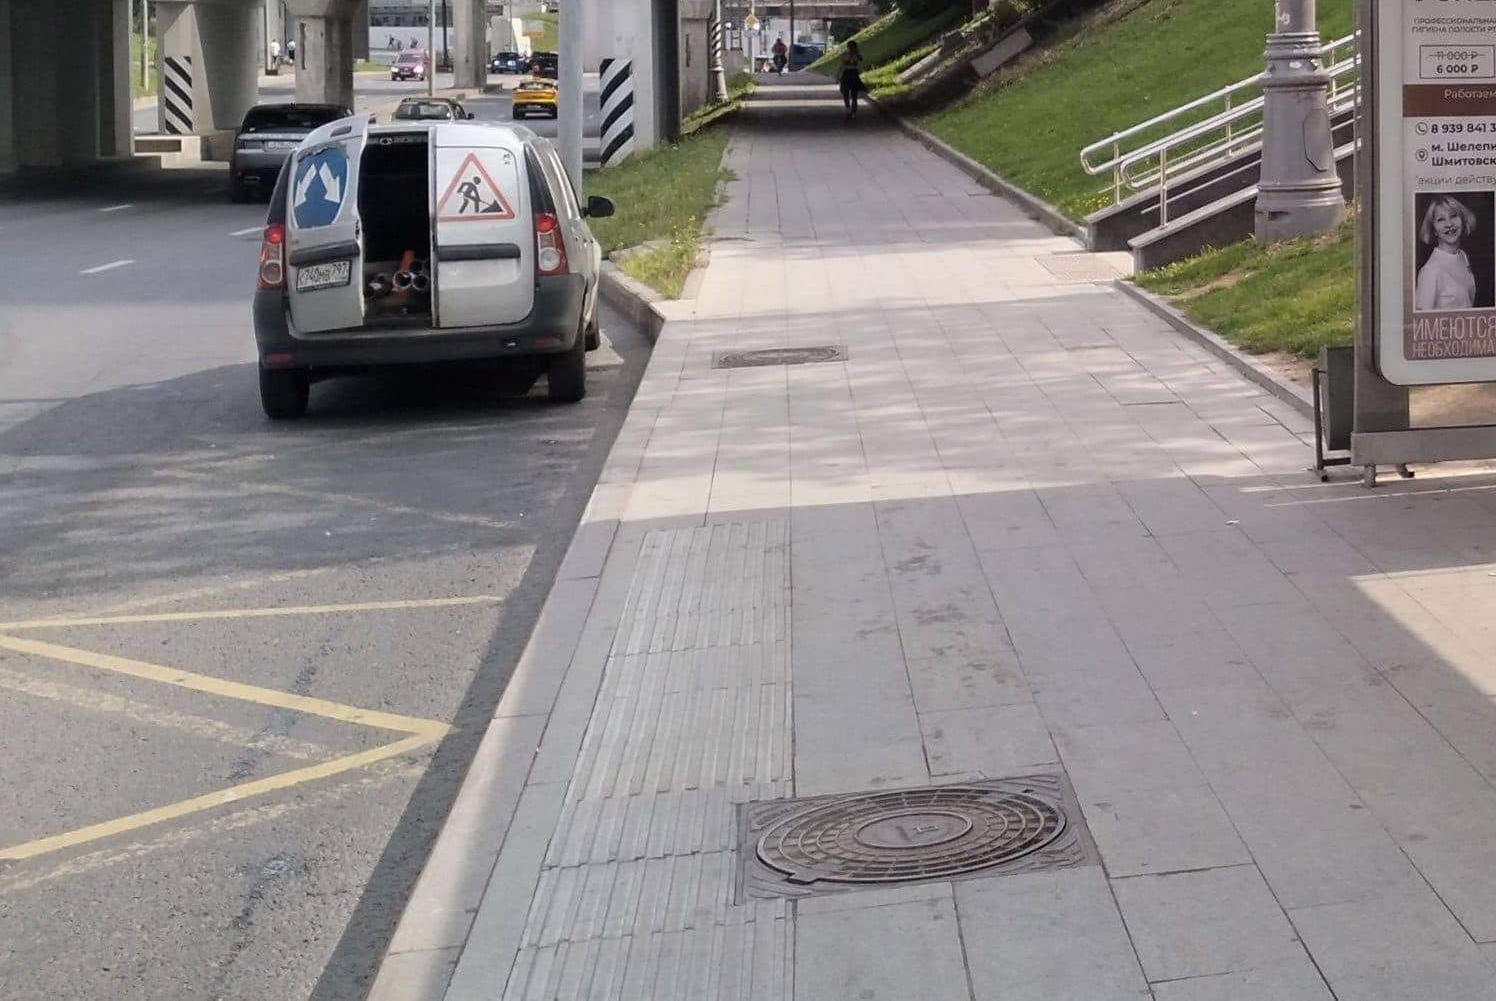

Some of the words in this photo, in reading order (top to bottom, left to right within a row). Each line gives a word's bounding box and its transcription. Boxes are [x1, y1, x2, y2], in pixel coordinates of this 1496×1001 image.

[1436, 64, 1443, 74] 6
[1446, 64, 1468, 74] 000
[1431, 124, 1438, 134] 8
[1441, 123, 1463, 133] 939
[1466, 123, 1486, 133] 841
[1431, 144, 1444, 152] м.
[1412, 339, 1495, 358] НЕОБХОДИМА
